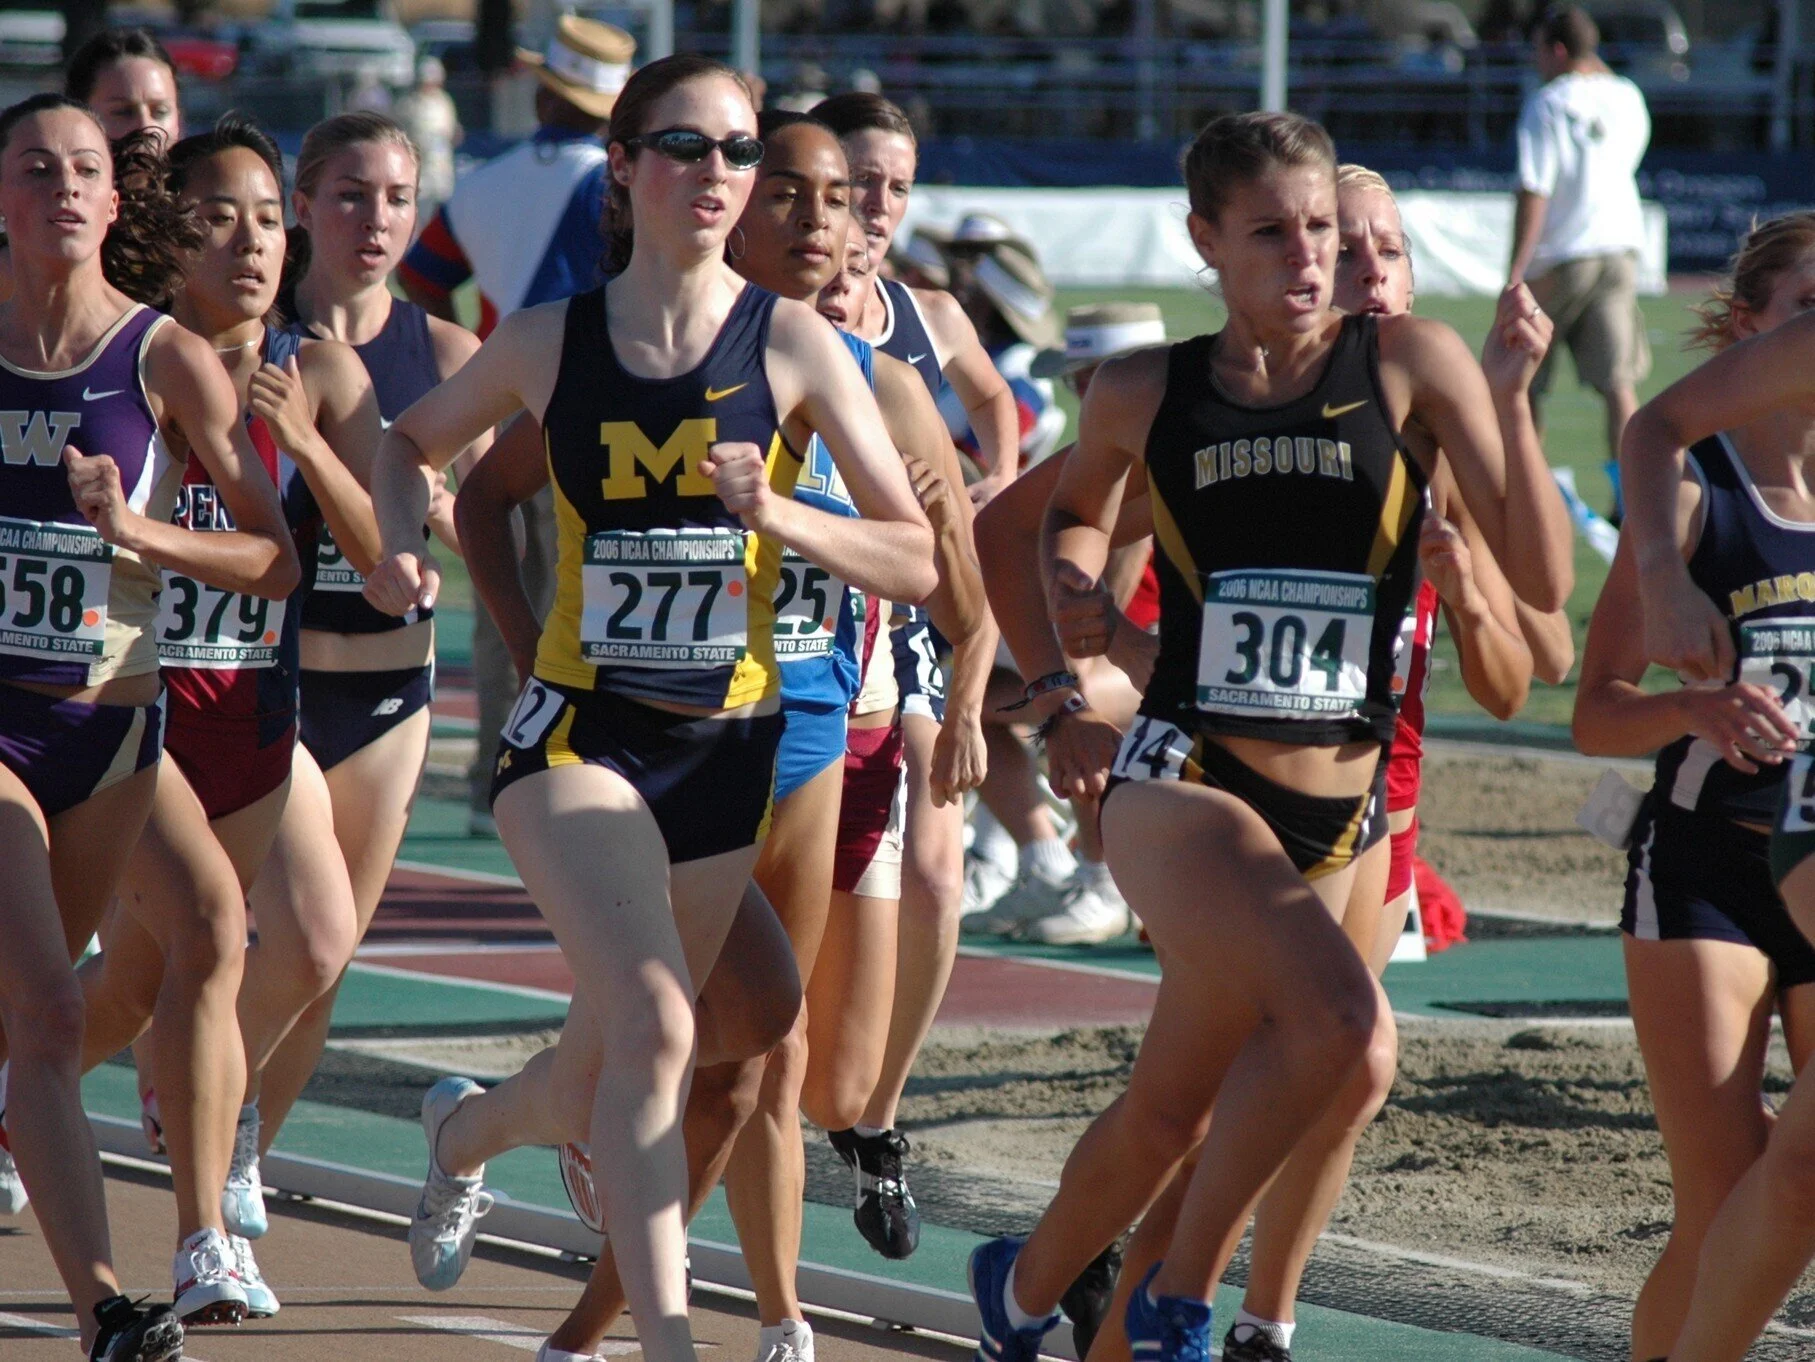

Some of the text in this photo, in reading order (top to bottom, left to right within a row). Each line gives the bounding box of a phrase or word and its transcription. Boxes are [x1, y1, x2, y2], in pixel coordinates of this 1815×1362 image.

[0, 411, 81, 466] W
[600, 418, 717, 500] M
[1195, 436, 1353, 490] MISSOURI
[22, 530, 104, 556] CHAMPIONSHIPS
[593, 539, 735, 560] 2006 NCAA CHAMPIONSHIPS
[0, 556, 85, 633] 58
[164, 576, 269, 645] 379
[606, 570, 723, 641] 277
[1218, 578, 1367, 609] 2006 NCAA CHAMPIONSHIPS
[52, 638, 94, 653] STATE
[239, 647, 273, 660] STATE
[590, 643, 735, 660] SACRAMENTO STATE
[798, 638, 828, 652] STATE
[1225, 611, 1347, 692] 304
[1752, 631, 1780, 651] 2006
[507, 680, 547, 744] 12
[1208, 687, 1354, 712] SACRAMENTO STATE
[1121, 716, 1180, 778] 14
